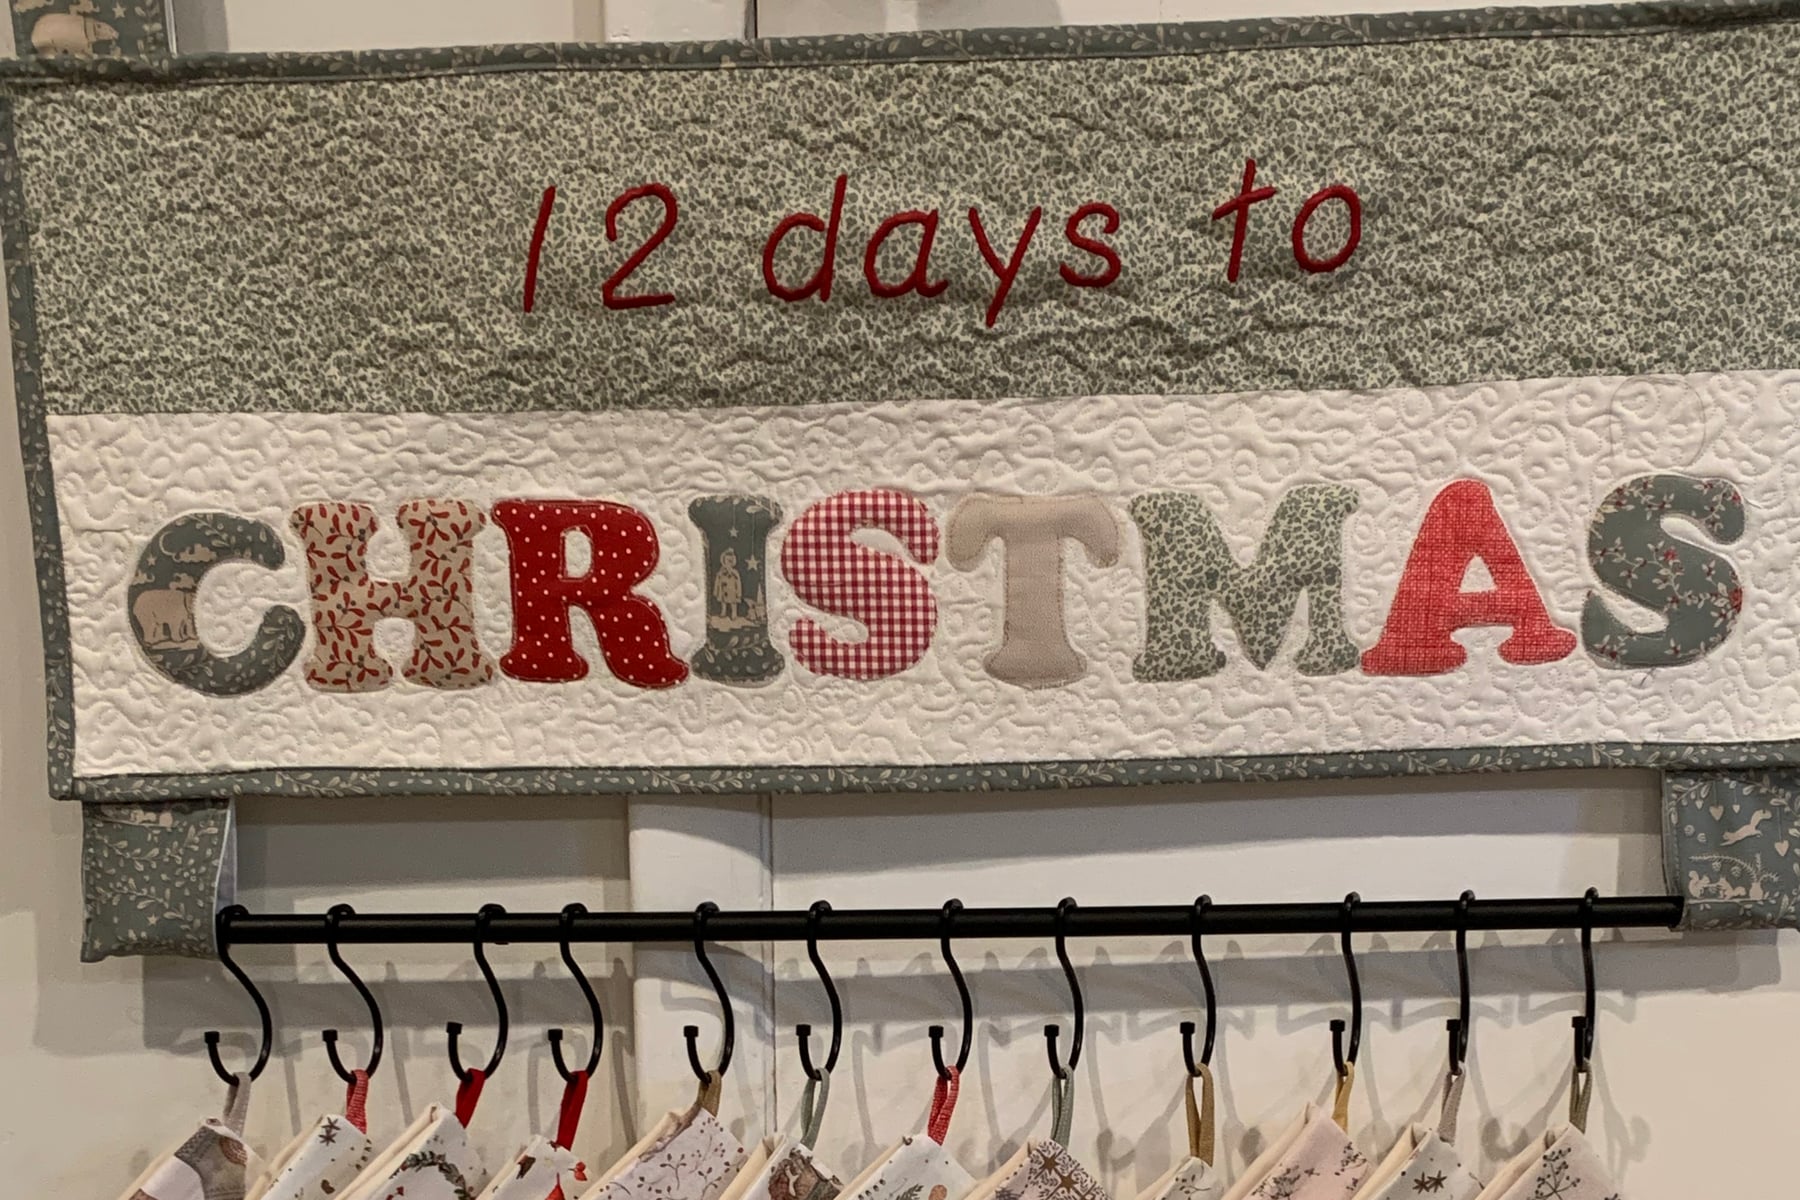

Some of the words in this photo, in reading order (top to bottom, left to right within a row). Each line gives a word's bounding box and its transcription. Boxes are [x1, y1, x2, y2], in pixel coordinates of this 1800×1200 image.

[522, 183, 679, 314] 12
[761, 173, 1123, 329] days
[1211, 158, 1363, 285] to
[127, 474, 1746, 698] CHRISTMAS
